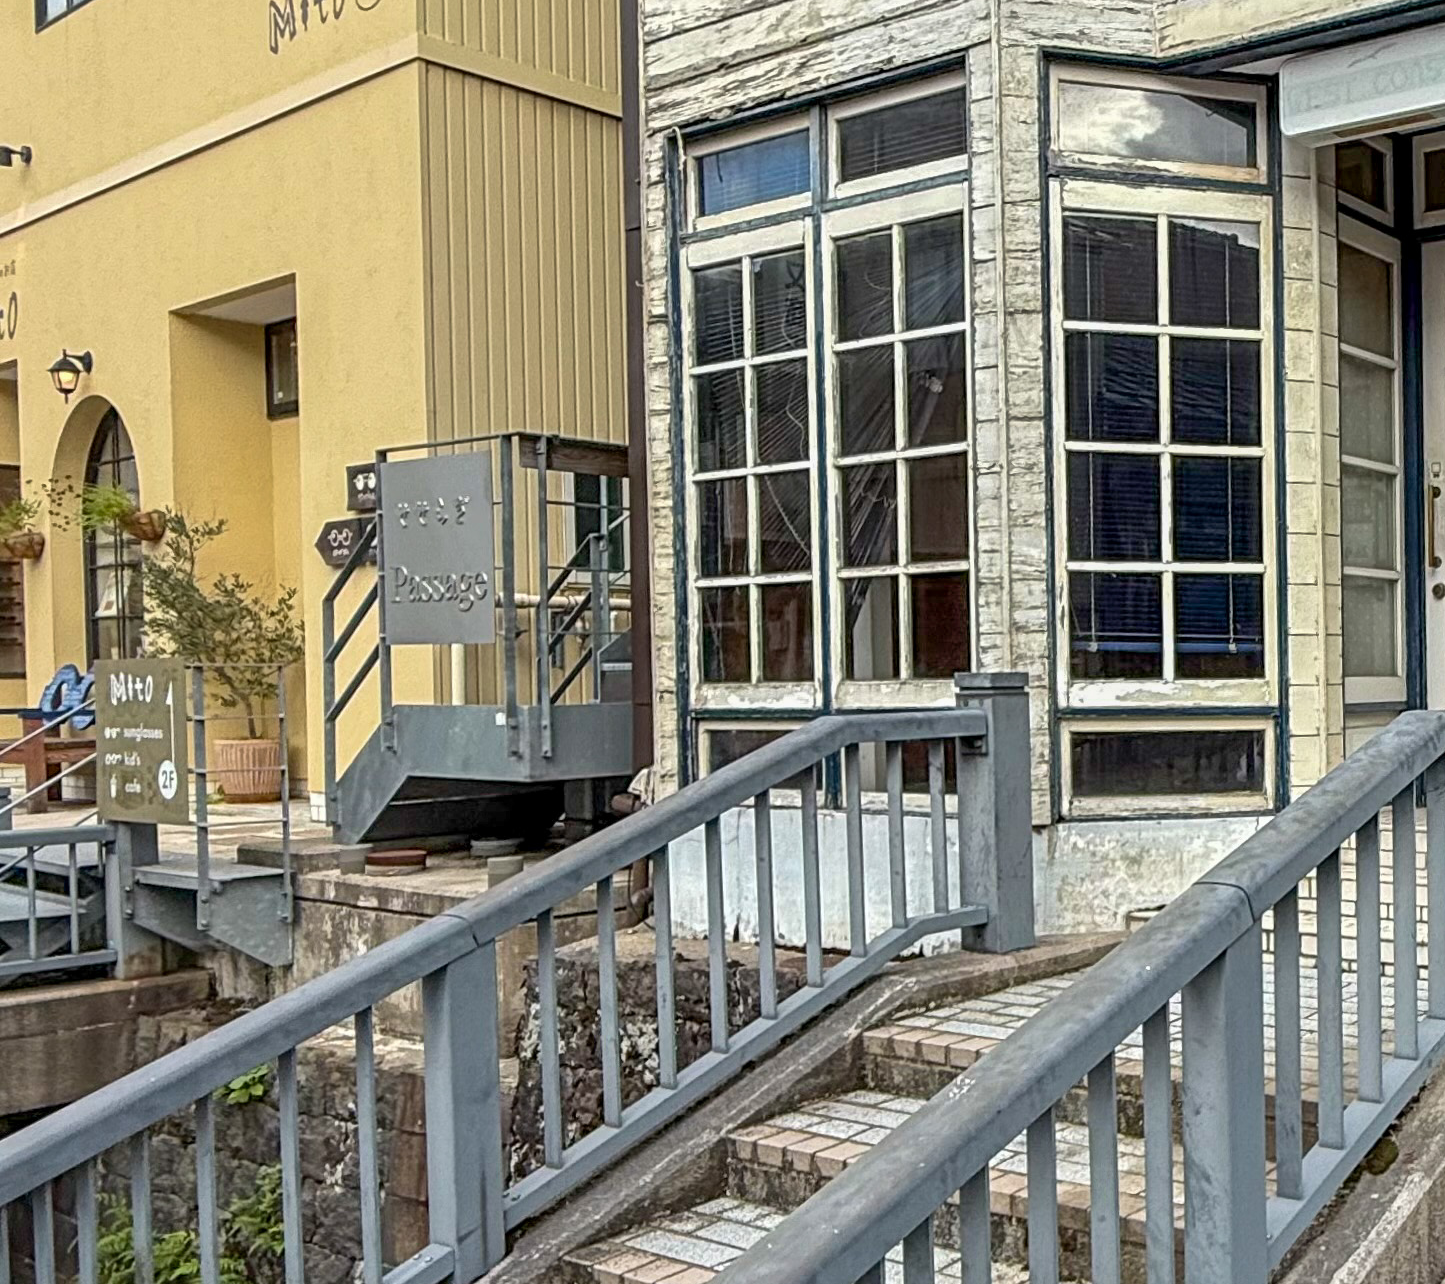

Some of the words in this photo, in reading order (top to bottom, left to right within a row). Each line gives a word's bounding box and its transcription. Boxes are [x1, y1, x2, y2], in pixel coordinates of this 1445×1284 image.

[390, 565, 489, 613] Passage
[123, 723, 164, 742] sunglasses
[124, 751, 141, 766] kid's
[161, 770, 175, 790] 2F
